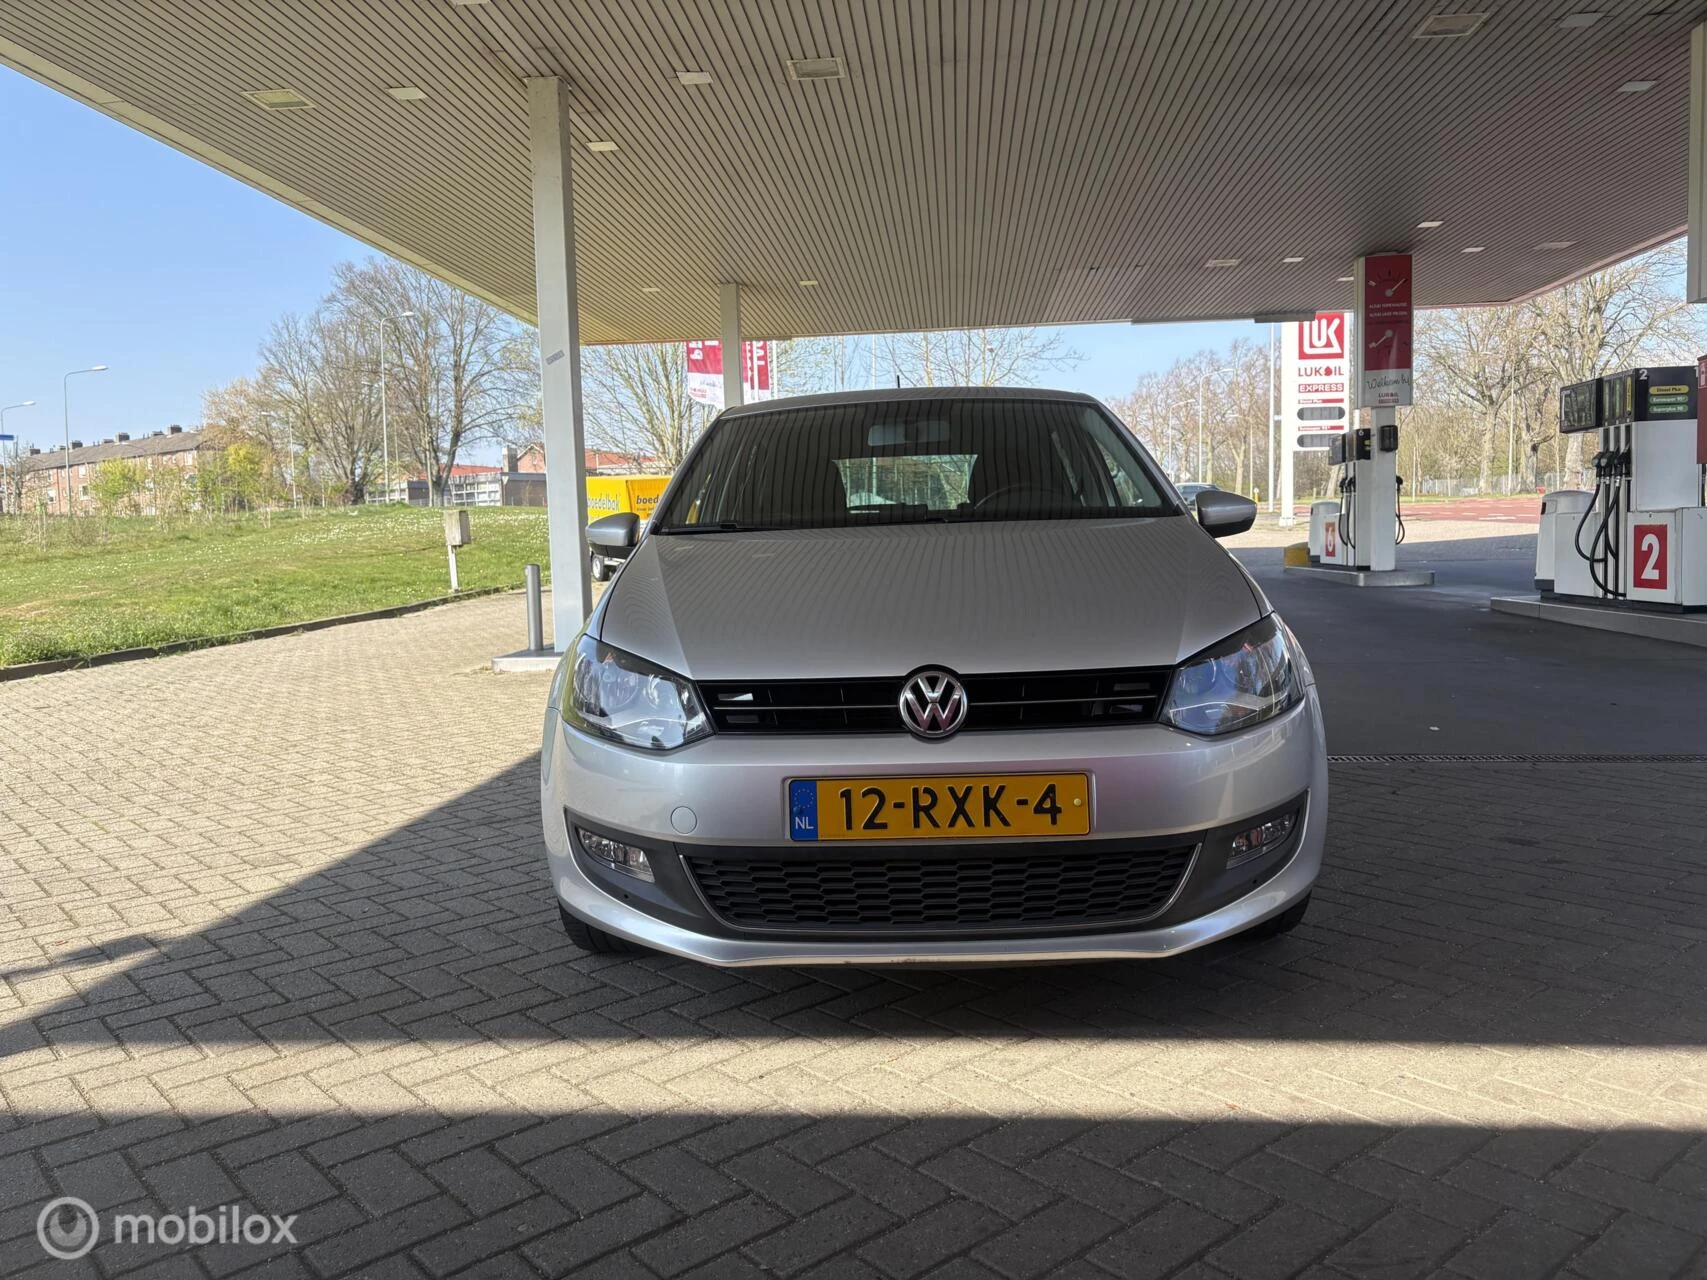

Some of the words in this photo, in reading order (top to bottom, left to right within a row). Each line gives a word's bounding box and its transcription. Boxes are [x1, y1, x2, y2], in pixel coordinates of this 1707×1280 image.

[1639, 369, 1648, 380] 2
[1299, 383, 1343, 392] EXPRESS
[1641, 533, 1660, 580] 2
[839, 783, 1063, 831] 12-RXK-4
[795, 816, 814, 830] NL
